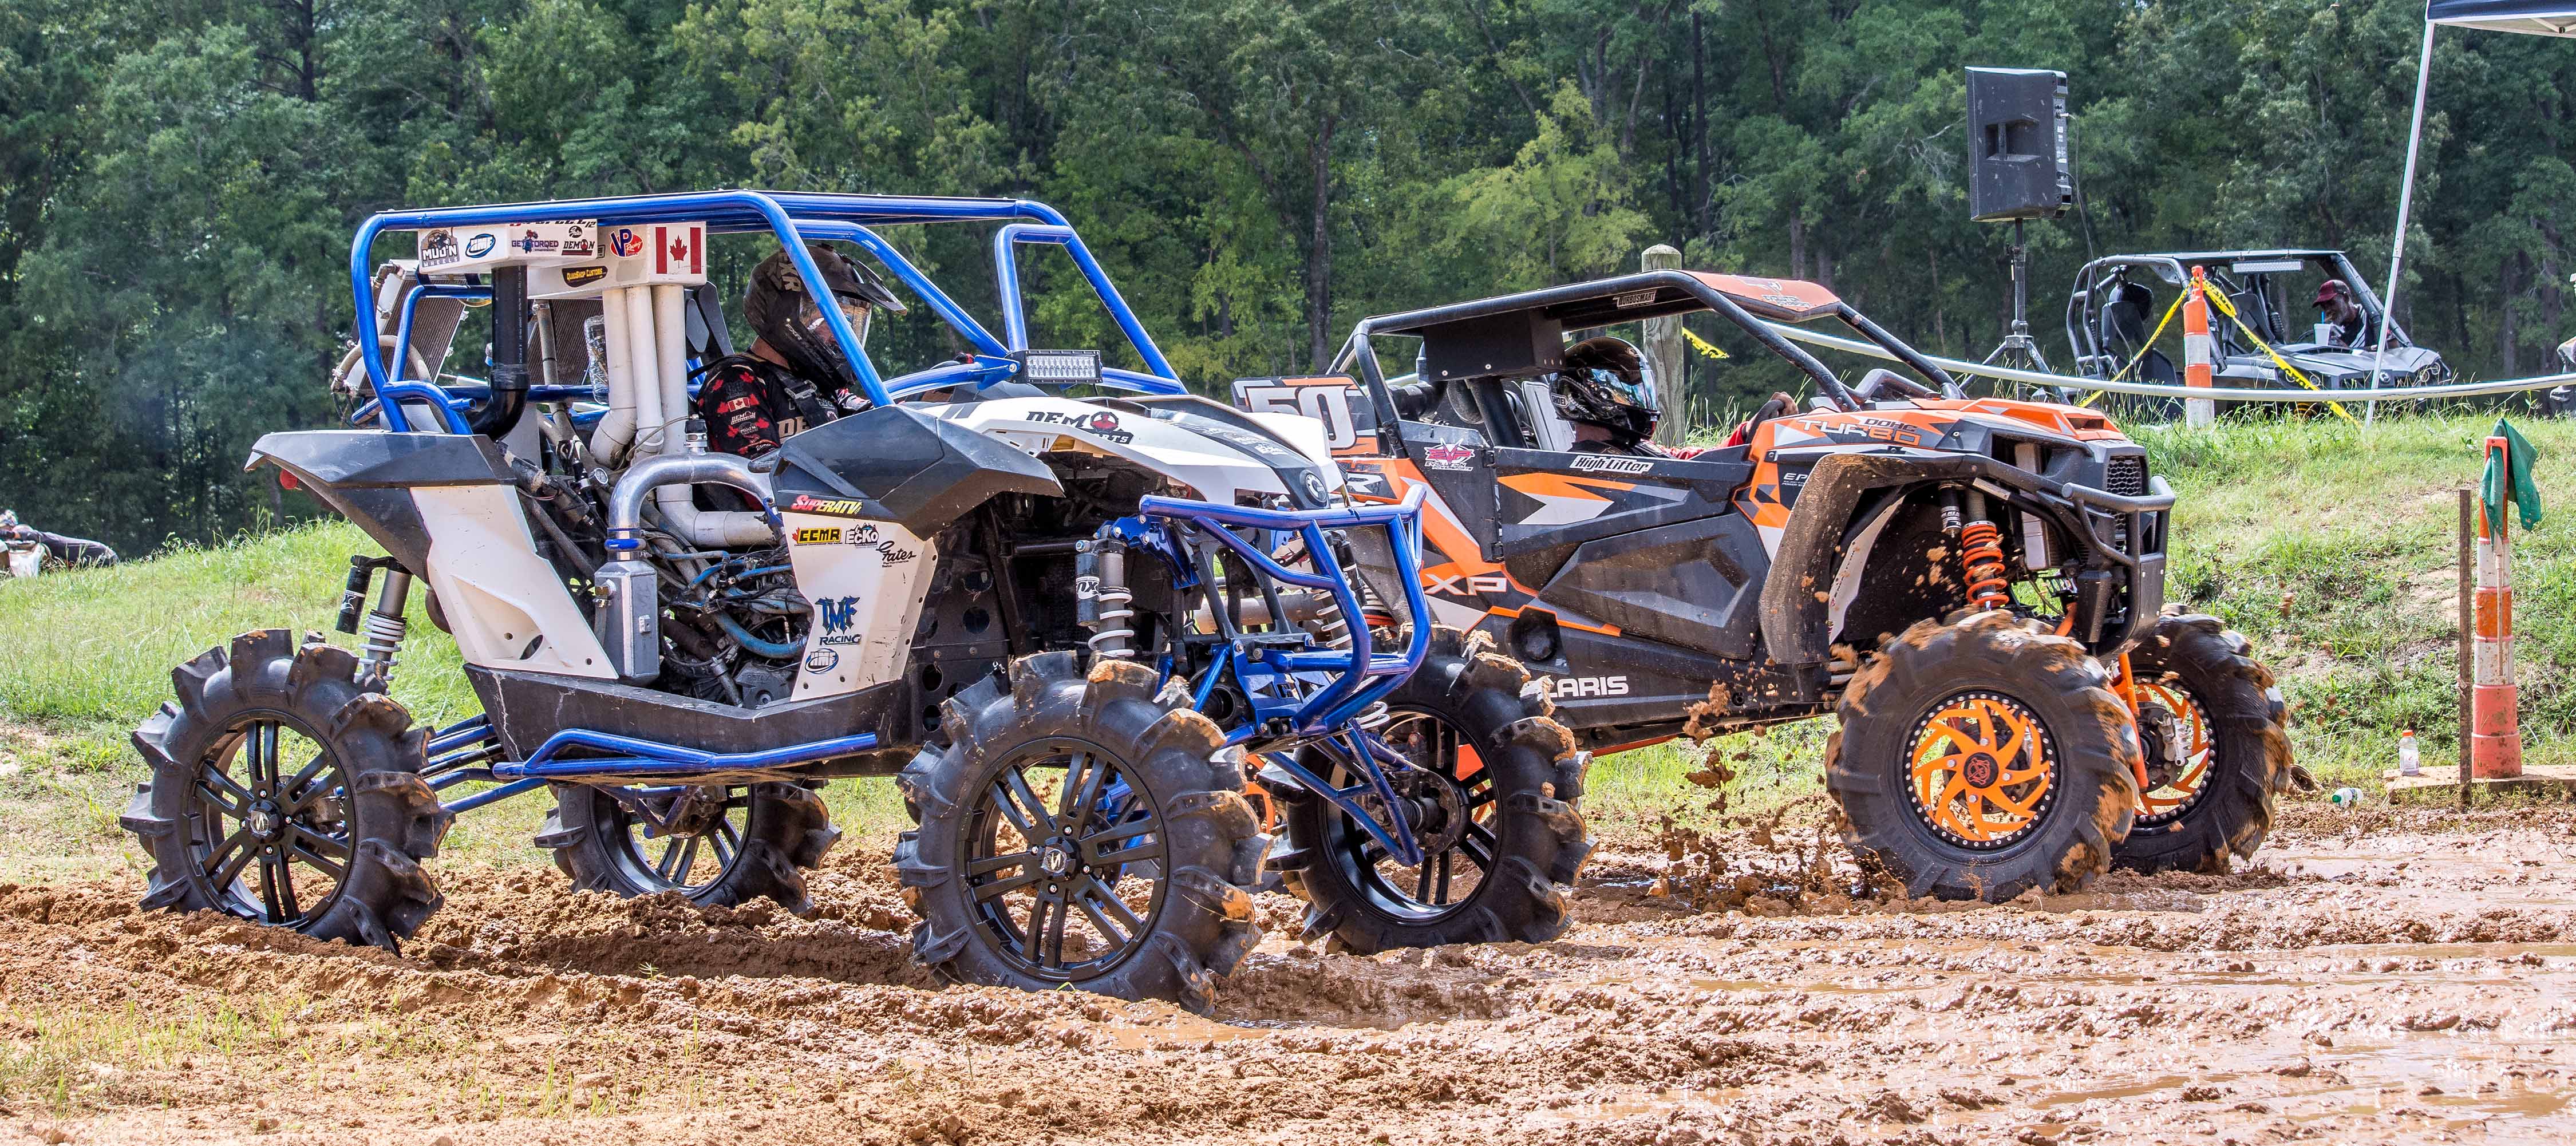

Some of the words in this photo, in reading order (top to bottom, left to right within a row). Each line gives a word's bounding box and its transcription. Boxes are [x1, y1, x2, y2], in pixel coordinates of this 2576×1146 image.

[422, 244, 457, 260] MUD'N
[610, 228, 633, 257] VP
[424, 256, 457, 267] WHEELS
[1797, 418, 1922, 446] TURBO
[1864, 418, 1918, 432] DOHC
[875, 540, 917, 562] Gates
[1077, 581, 1099, 593] OX
[1424, 573, 1507, 596] XP
[819, 634, 862, 646] RACING
[1549, 675, 1629, 698] ARIS
